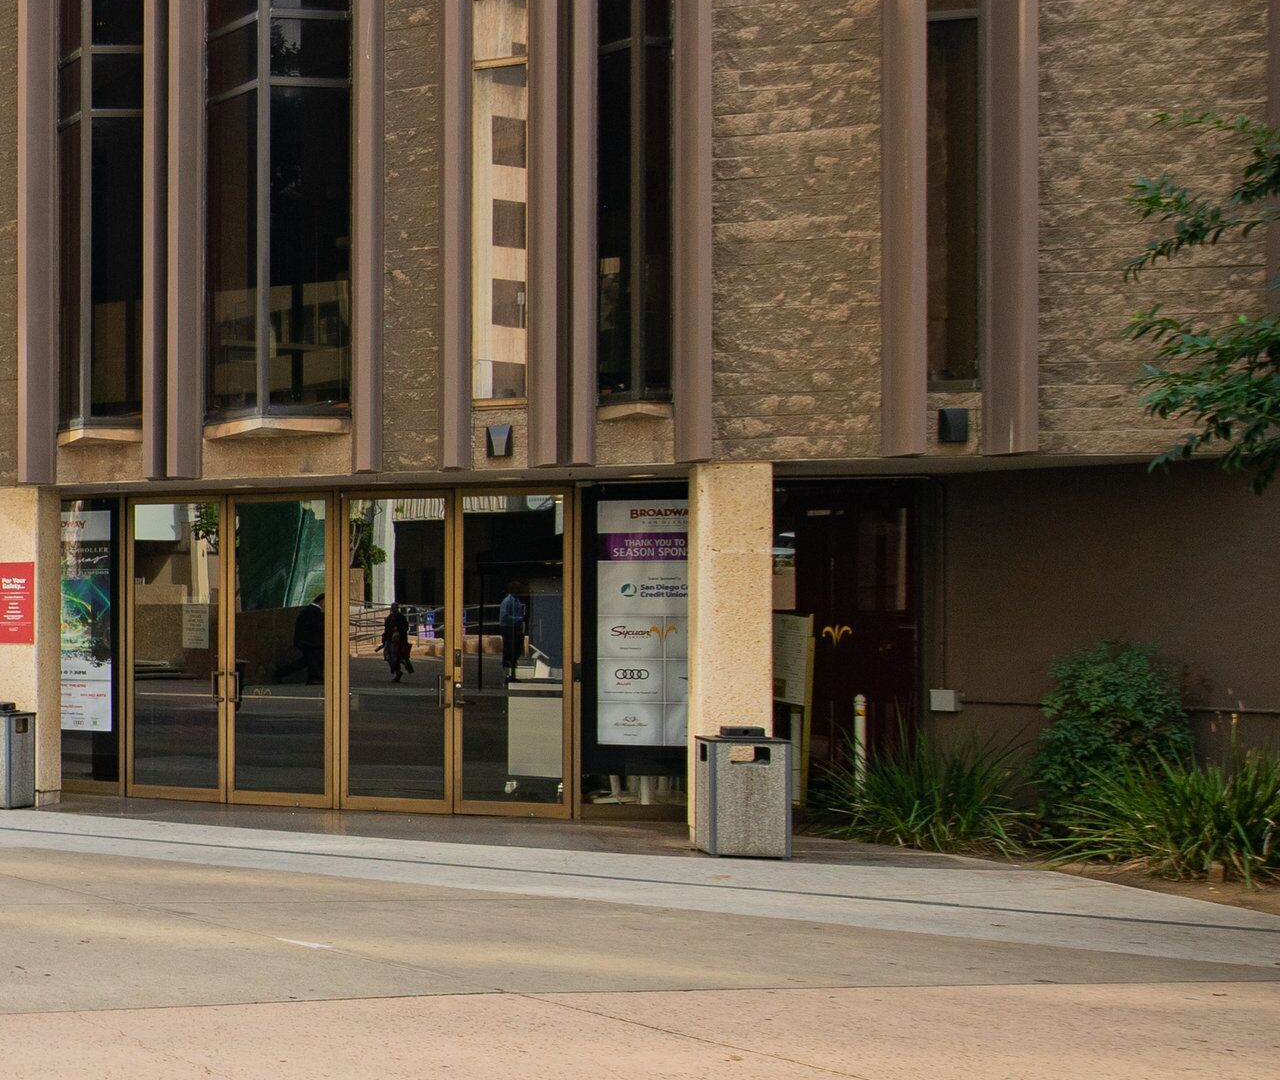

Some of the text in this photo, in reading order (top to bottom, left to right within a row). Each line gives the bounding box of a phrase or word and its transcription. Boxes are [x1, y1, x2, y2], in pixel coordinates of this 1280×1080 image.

[629, 508, 688, 519] BROADWA
[624, 538, 686, 547] THANK YOU TO
[613, 547, 655, 557] SEASON
[656, 584, 680, 592] Diego
[610, 625, 651, 639] Sycuan
